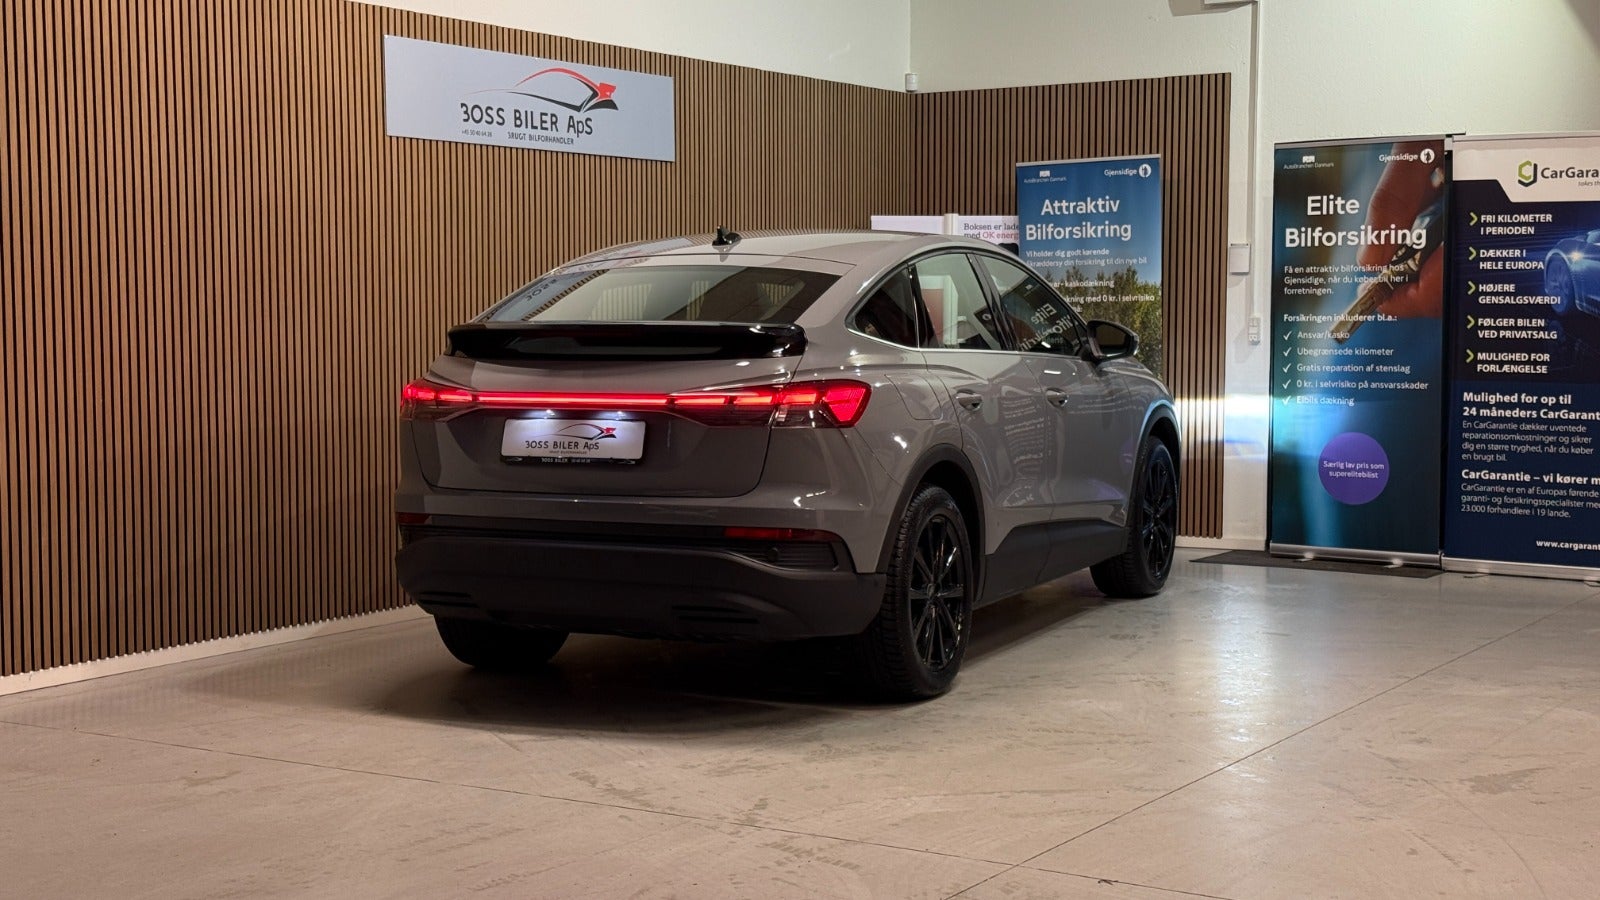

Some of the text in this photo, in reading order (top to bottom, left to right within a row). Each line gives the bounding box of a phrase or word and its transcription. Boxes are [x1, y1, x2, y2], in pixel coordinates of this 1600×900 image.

[513, 109, 559, 132] BILER
[566, 115, 593, 138] ApS
[528, 133, 575, 145] BILFORHANDLER
[1379, 154, 1418, 162] Gjensidige
[1104, 168, 1138, 178] Gjensidige
[1041, 195, 1120, 216] Attraktiv
[1307, 194, 1360, 216] Elite
[1480, 214, 1553, 223] FRI KILOMETER
[963, 223, 992, 231] Boksen
[1025, 221, 1132, 241] Bilforsikring
[1480, 226, 1535, 235] I PERIODEN
[982, 231, 995, 239] OK
[1285, 224, 1427, 249] Bilforsikring
[1033, 249, 1054, 258] holder
[1055, 249, 1066, 258] dig
[1066, 249, 1082, 259] godt
[1082, 248, 1110, 256] kørende
[1479, 249, 1526, 258] DÆKKER I
[1075, 259, 1106, 268] forsikring
[1125, 258, 1137, 266] nye
[1284, 265, 1293, 273] Få
[1305, 265, 1339, 273] attraktiv
[1340, 264, 1388, 273] bilforsikring
[1388, 263, 1405, 272] hos
[1479, 261, 1545, 270] HELE EUROPA
[1064, 279, 1115, 288] kaskodækning
[1284, 275, 1327, 285] Gjensidige,
[1328, 275, 1340, 284] når
[1342, 275, 1353, 283] du
[1390, 274, 1404, 283] her
[1284, 286, 1334, 296] forretningen.
[1478, 283, 1516, 293] HØJERE
[1085, 294, 1102, 303] med
[1102, 294, 1108, 302] 0
[1108, 294, 1118, 302] kr.
[1121, 293, 1156, 302] selvrisiko
[1478, 295, 1561, 305] GENSALGSVÆRDI
[1283, 313, 1332, 322] Forsikringen
[1333, 313, 1376, 321] inkluderer
[1478, 317, 1545, 327] FØLGER BILEN
[1297, 330, 1350, 339] Ansvar/kasko
[1477, 330, 1558, 340] VED PRIVATSALG
[1297, 347, 1394, 357] Ubegrænsede kilometer
[1477, 352, 1551, 362] MULIGHED FOR
[1296, 363, 1411, 374] Gratis reparation af stenslag
[1477, 364, 1548, 374] FORLÆNGELSE
[1296, 379, 1302, 388] 0
[1304, 379, 1313, 388] kr.
[1319, 379, 1357, 388] selvrisiko
[1358, 380, 1369, 390] på
[1370, 381, 1429, 390] ansvarsskader
[1319, 395, 1355, 406] dækning
[1463, 392, 1572, 406] Mulighed for op til
[1463, 406, 1477, 417] 24
[1480, 407, 1537, 418] måneders
[1462, 420, 1588, 433] En CarGarantie dækker uventede
[1462, 432, 1593, 445] reparationsomkostninger og sikrer
[552, 441, 579, 450] BILER
[583, 442, 600, 452] ApS
[1462, 442, 1474, 452] dig
[1487, 443, 1510, 452] større
[1510, 444, 1543, 454] tryghed,
[1544, 445, 1557, 453] når
[1558, 445, 1569, 454] du
[1570, 446, 1593, 455] køber
[1473, 453, 1495, 463] brugt
[1496, 453, 1508, 462] bil.
[1323, 460, 1345, 470] Særlig
[1345, 461, 1356, 469] lav
[1356, 462, 1369, 470] pris
[1328, 470, 1379, 479] superelitebilist
[1461, 469, 1531, 482] CarGarantie
[1543, 472, 1554, 483] vi
[1556, 472, 1588, 485] kører
[1461, 483, 1506, 493] CarGarantie
[1527, 486, 1536, 494] af
[1536, 486, 1567, 497] Europas
[1568, 488, 1600, 498] førende
[1461, 494, 1490, 504] garanti-
[1491, 496, 1502, 505] og
[1503, 495, 1584, 508] forsikringsspecialister
[1461, 504, 1486, 513] 23.000
[1487, 504, 1531, 515] forhandlere
[1537, 508, 1546, 516] 19
[1547, 508, 1571, 518] lande.
